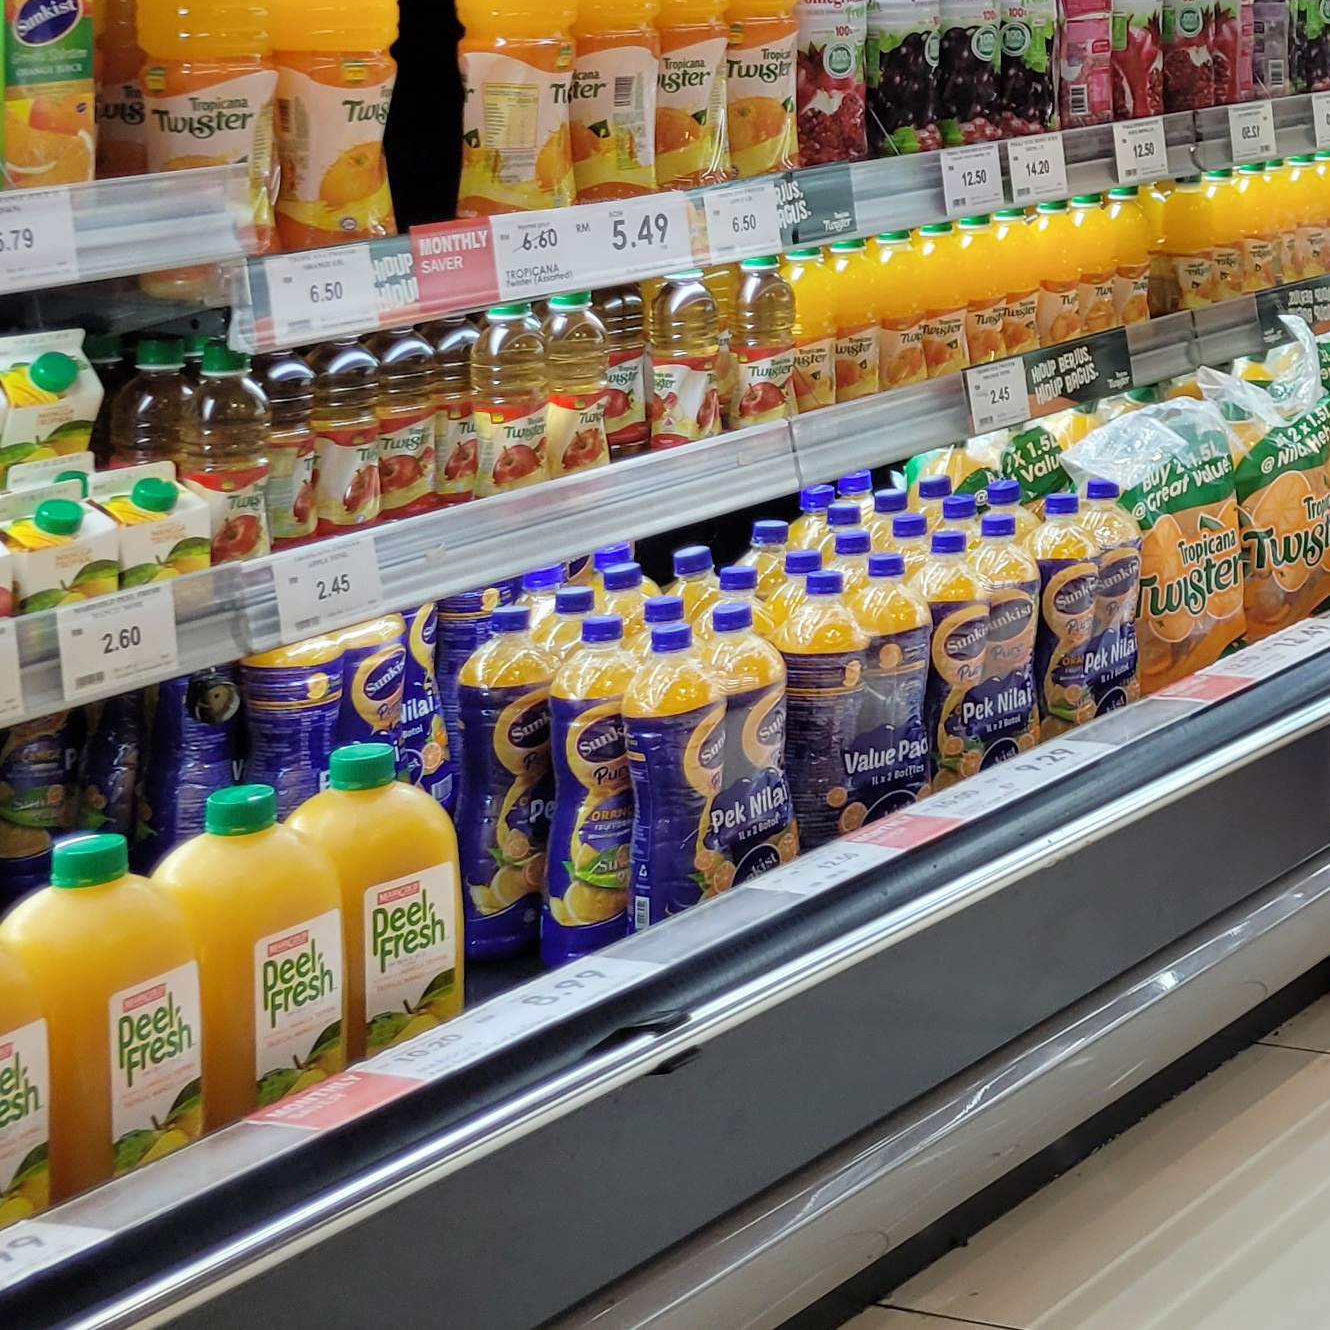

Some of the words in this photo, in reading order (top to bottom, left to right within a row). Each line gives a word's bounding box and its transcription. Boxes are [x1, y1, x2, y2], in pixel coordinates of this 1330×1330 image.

[189, 96, 249, 111] Tropicana
[152, 110, 253, 139] Twister
[1133, 143, 1154, 158] 12.50
[962, 170, 987, 186] 12.50
[1026, 160, 1050, 176] 14.20
[576, 222, 590, 232] RM
[613, 213, 669, 250] 5.49
[732, 214, 756, 233] 6.50
[419, 231, 488, 255] MONTHLY
[421, 256, 463, 272] SAVER
[505, 264, 559, 279] TROPICANA
[310, 281, 342, 303] 6.50
[990, 386, 1011, 404] 2.45
[1179, 530, 1236, 565] Tropicana
[317, 575, 350, 600] 2.45
[1137, 554, 1242, 617] Twister
[103, 626, 141, 653] 2.60
[1084, 647, 1109, 673] Pek
[1112, 636, 1137, 665] Nilai
[963, 698, 993, 724] Pek
[997, 684, 1031, 713] Nilai
[711, 802, 747, 832] Pek
[750, 785, 788, 820] Nilai
[373, 891, 427, 952] Peel
[380, 915, 445, 972] Fresh
[262, 939, 316, 992] Peel
[270, 964, 335, 1027] Fresh
[118, 994, 174, 1066] Peel
[127, 1020, 192, 1086] Fresh
